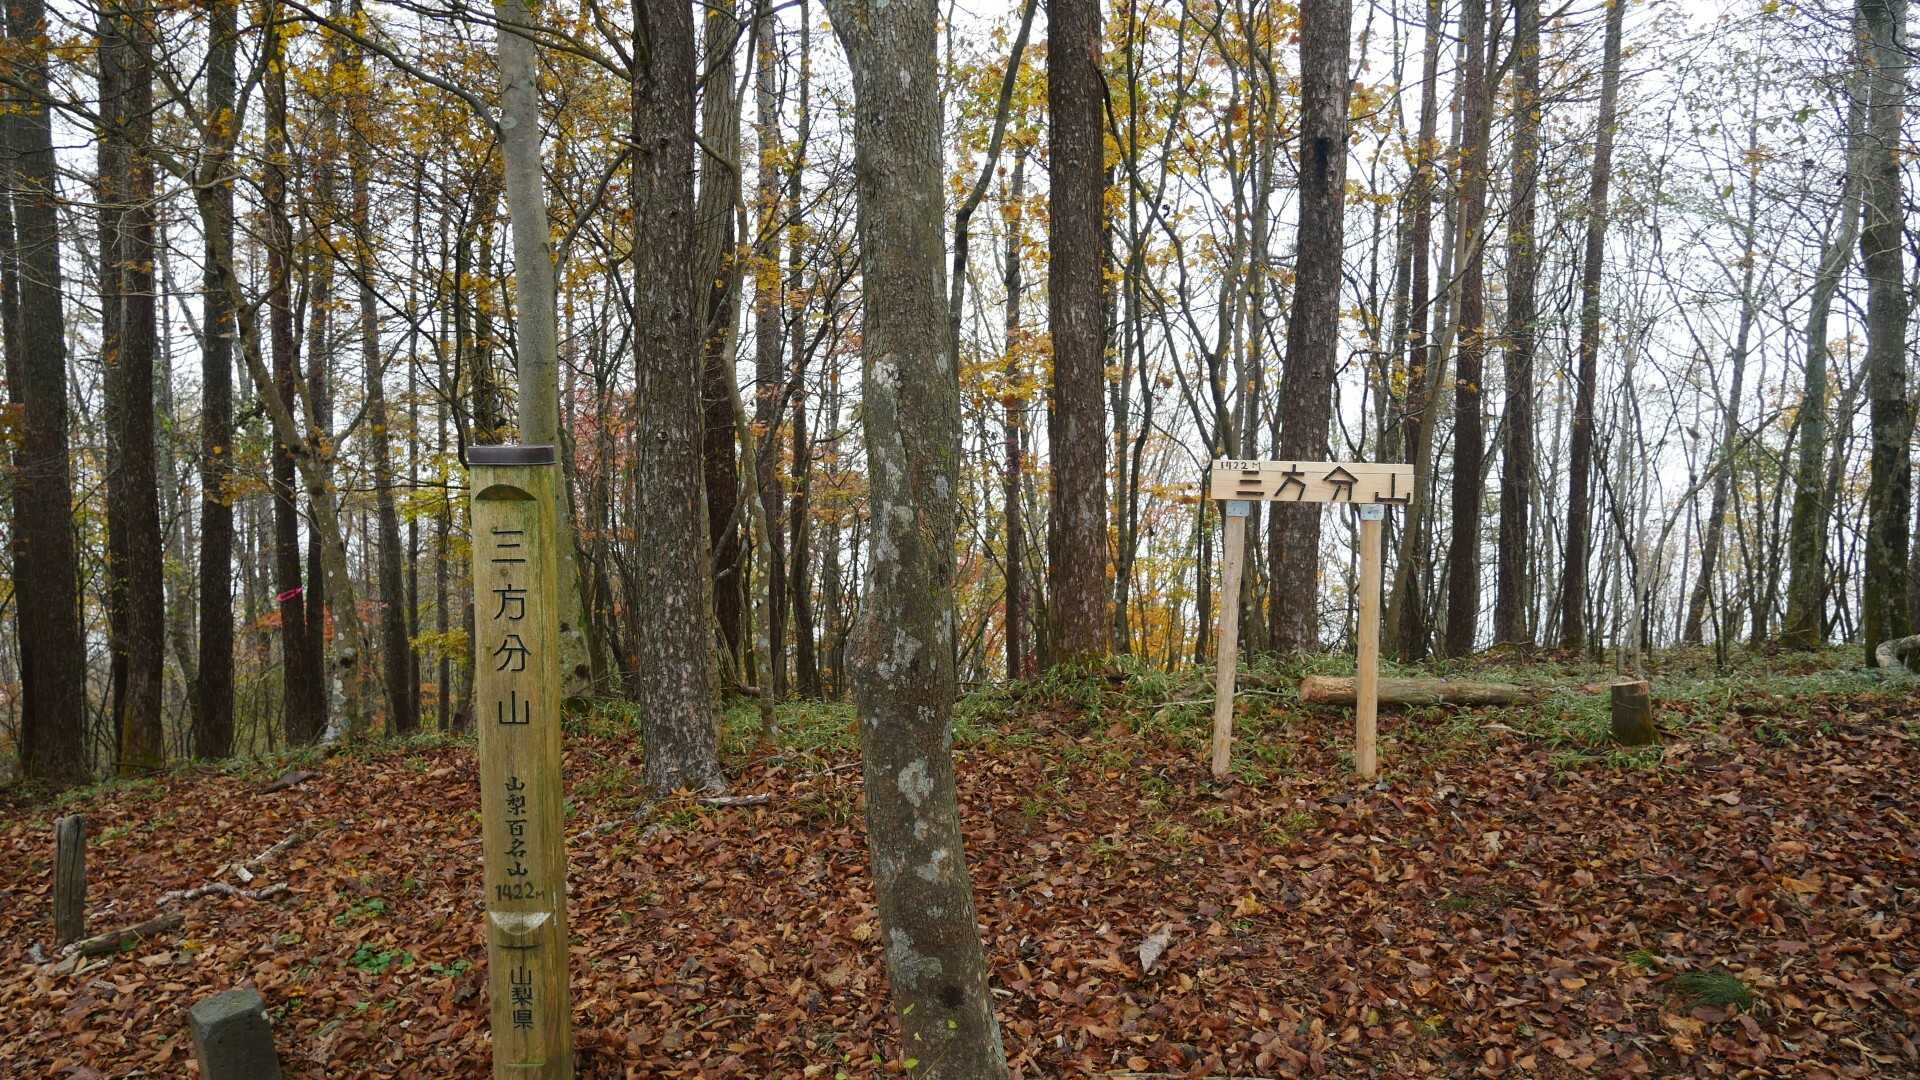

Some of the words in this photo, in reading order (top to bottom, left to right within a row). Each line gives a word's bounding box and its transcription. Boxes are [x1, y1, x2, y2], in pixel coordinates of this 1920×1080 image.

[1235, 463, 1411, 502] 三方分山
[491, 529, 532, 724] 三方分山
[504, 776, 529, 877] 山梨百名山
[510, 966, 534, 1032] 山梨県
